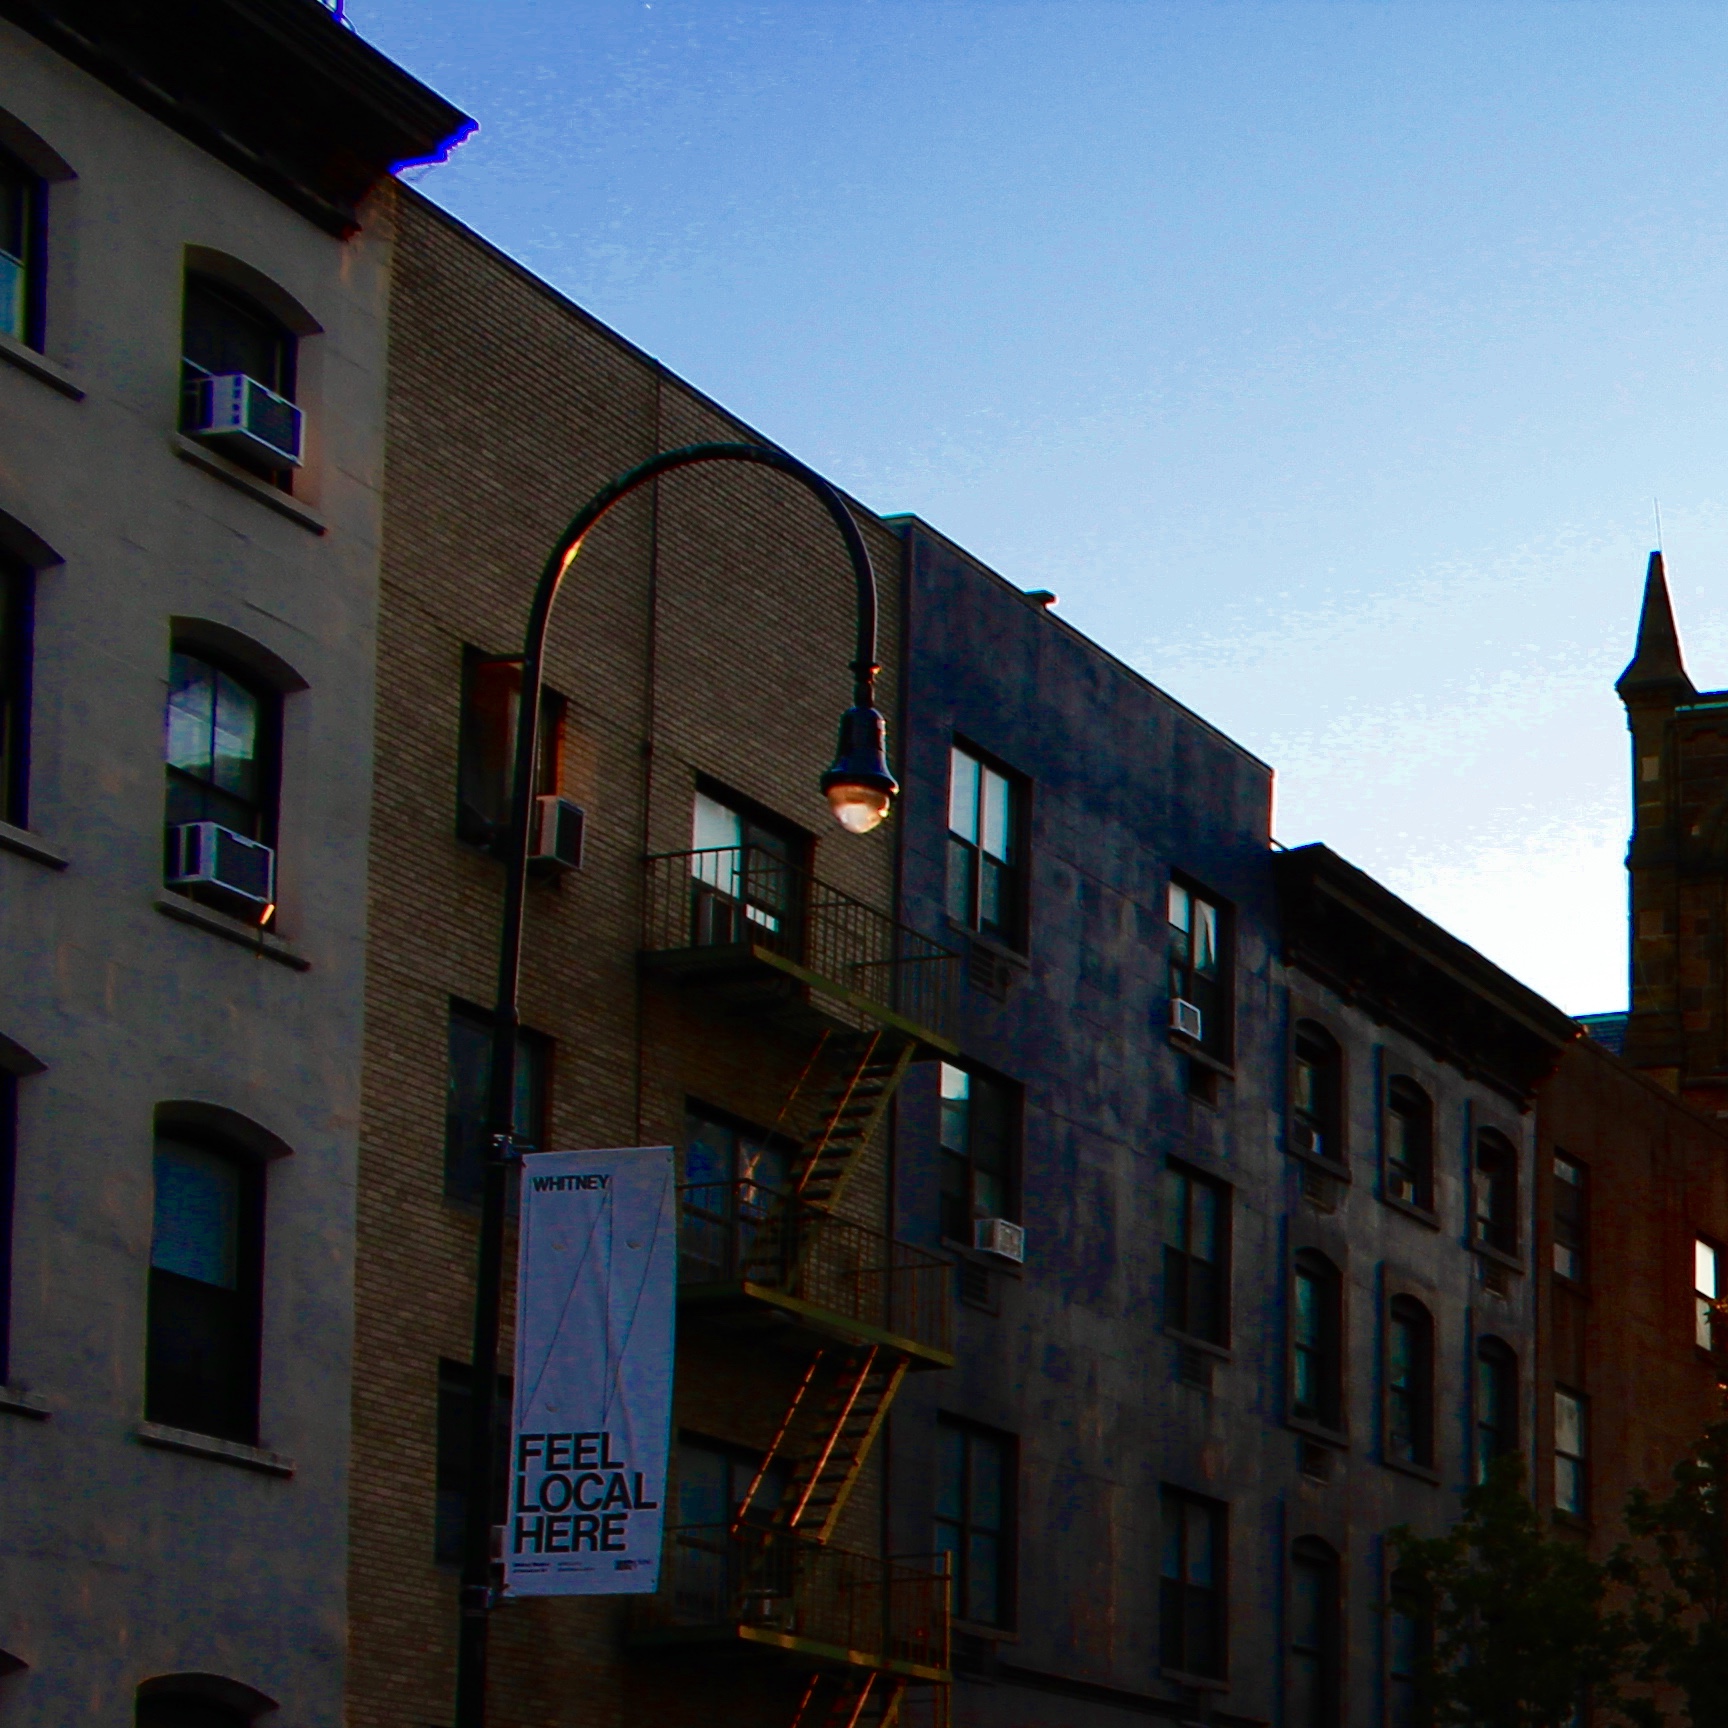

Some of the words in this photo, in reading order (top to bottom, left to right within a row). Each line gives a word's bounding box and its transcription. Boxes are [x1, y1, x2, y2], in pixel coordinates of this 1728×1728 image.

[532, 1174, 611, 1191] WHITNEY
[517, 1432, 625, 1471] FEEL
[516, 1472, 657, 1513] LOCAL
[513, 1513, 629, 1554] HERE
